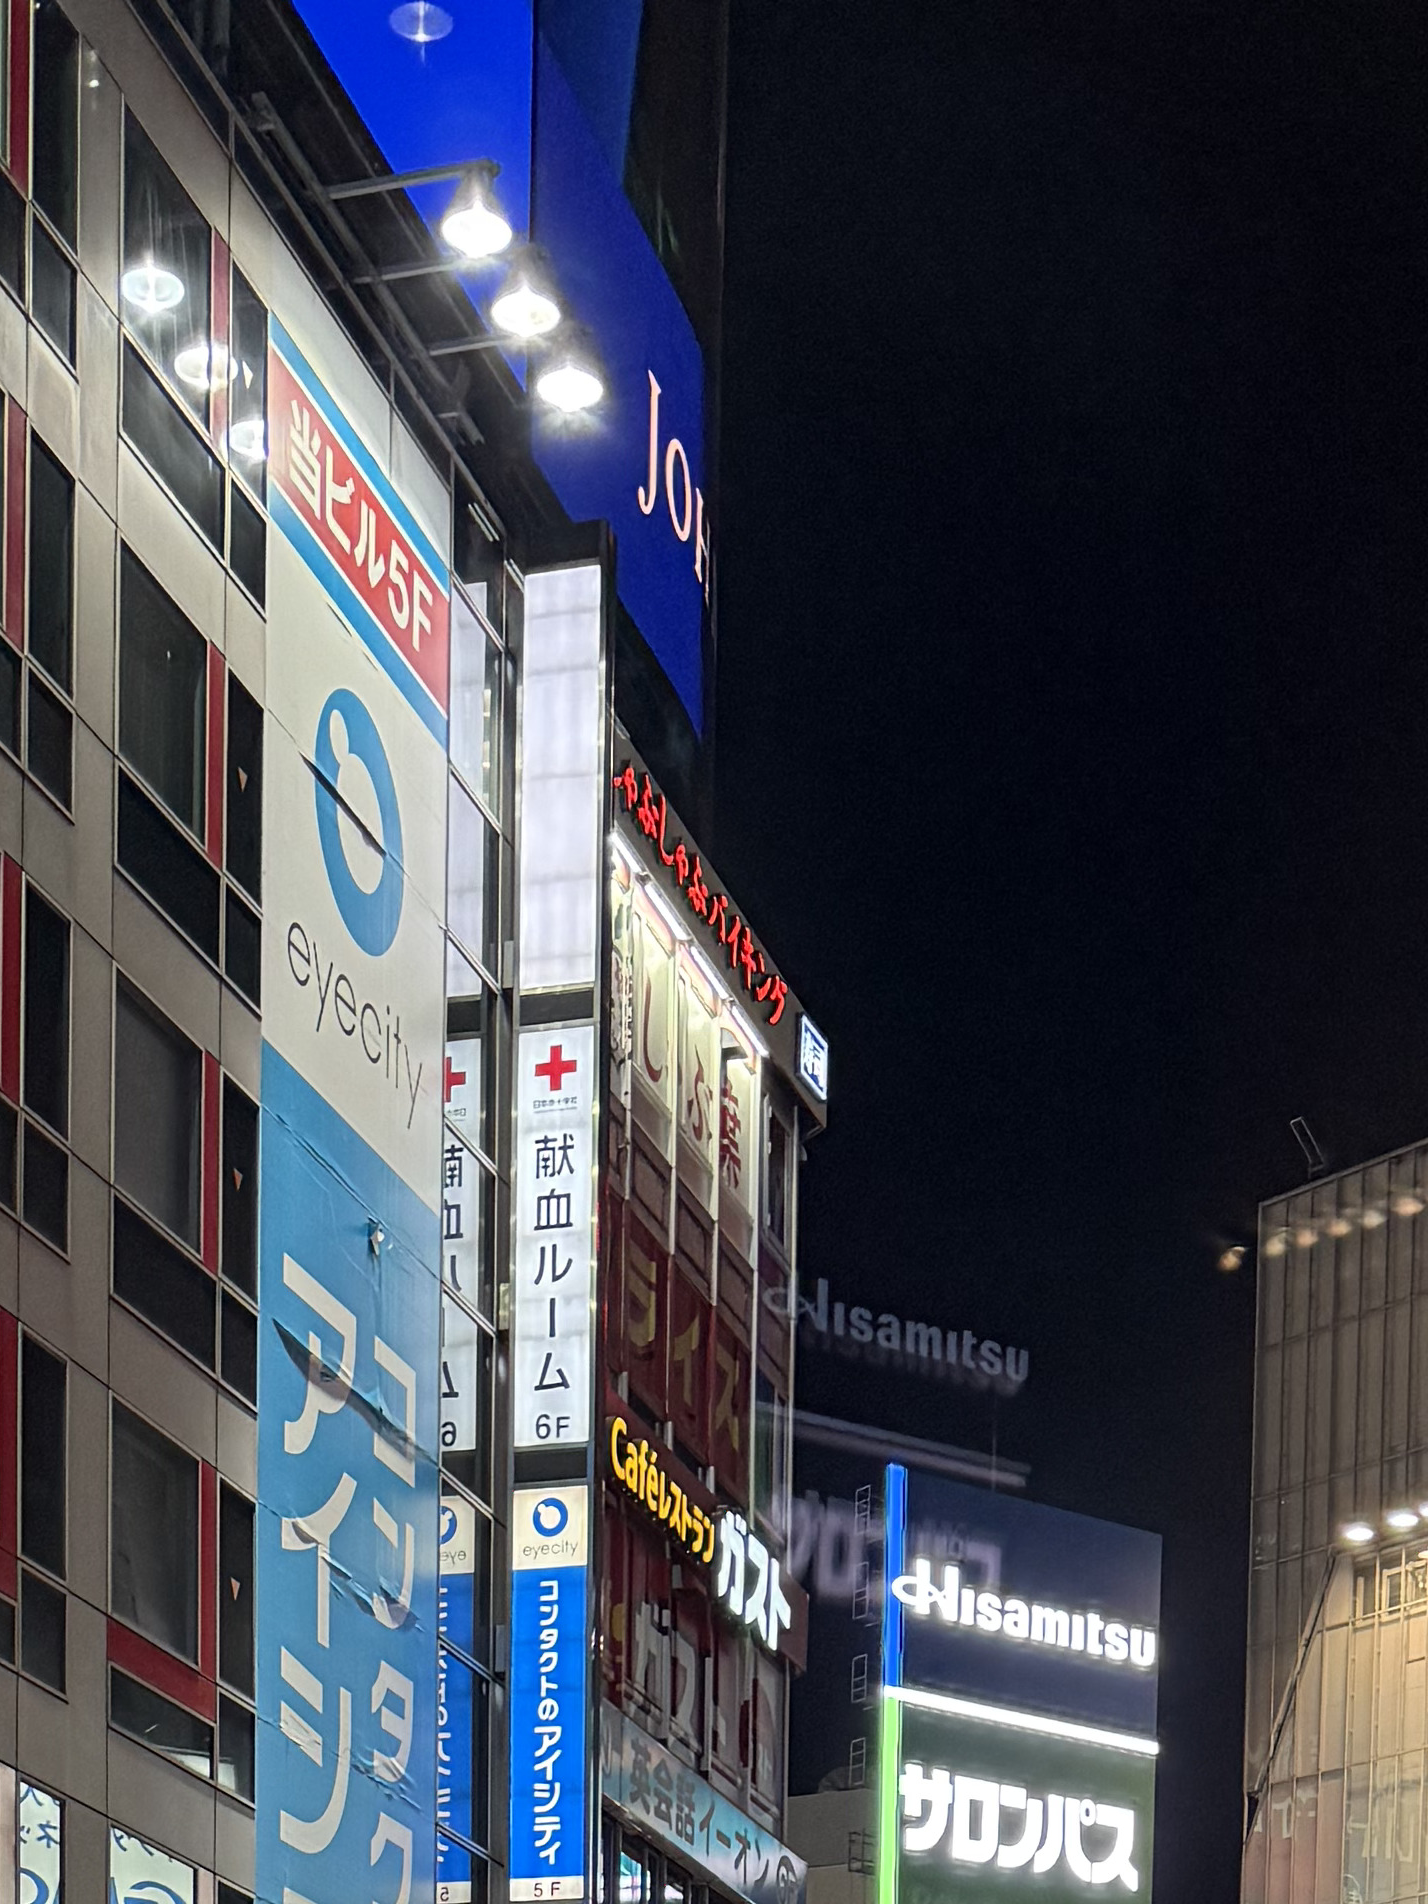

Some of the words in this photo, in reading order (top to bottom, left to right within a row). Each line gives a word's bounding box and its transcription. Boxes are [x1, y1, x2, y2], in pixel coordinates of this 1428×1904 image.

[289, 397, 433, 653] 当ビル5F
[613, 766, 788, 1025] ゃぶしゃぶバイキング
[287, 921, 423, 1130] eyecity
[534, 1134, 573, 1392] 献血ルーム
[535, 1412, 571, 1440] 6F
[521, 1537, 579, 1559] eyecity
[717, 1510, 791, 1651] ガスト
[891, 1557, 1158, 1669] Hisamitsu
[532, 1580, 562, 1865] コンタクトのアイシティ
[533, 1881, 561, 1898] 5F
[899, 1761, 1140, 1892] サロンパス
